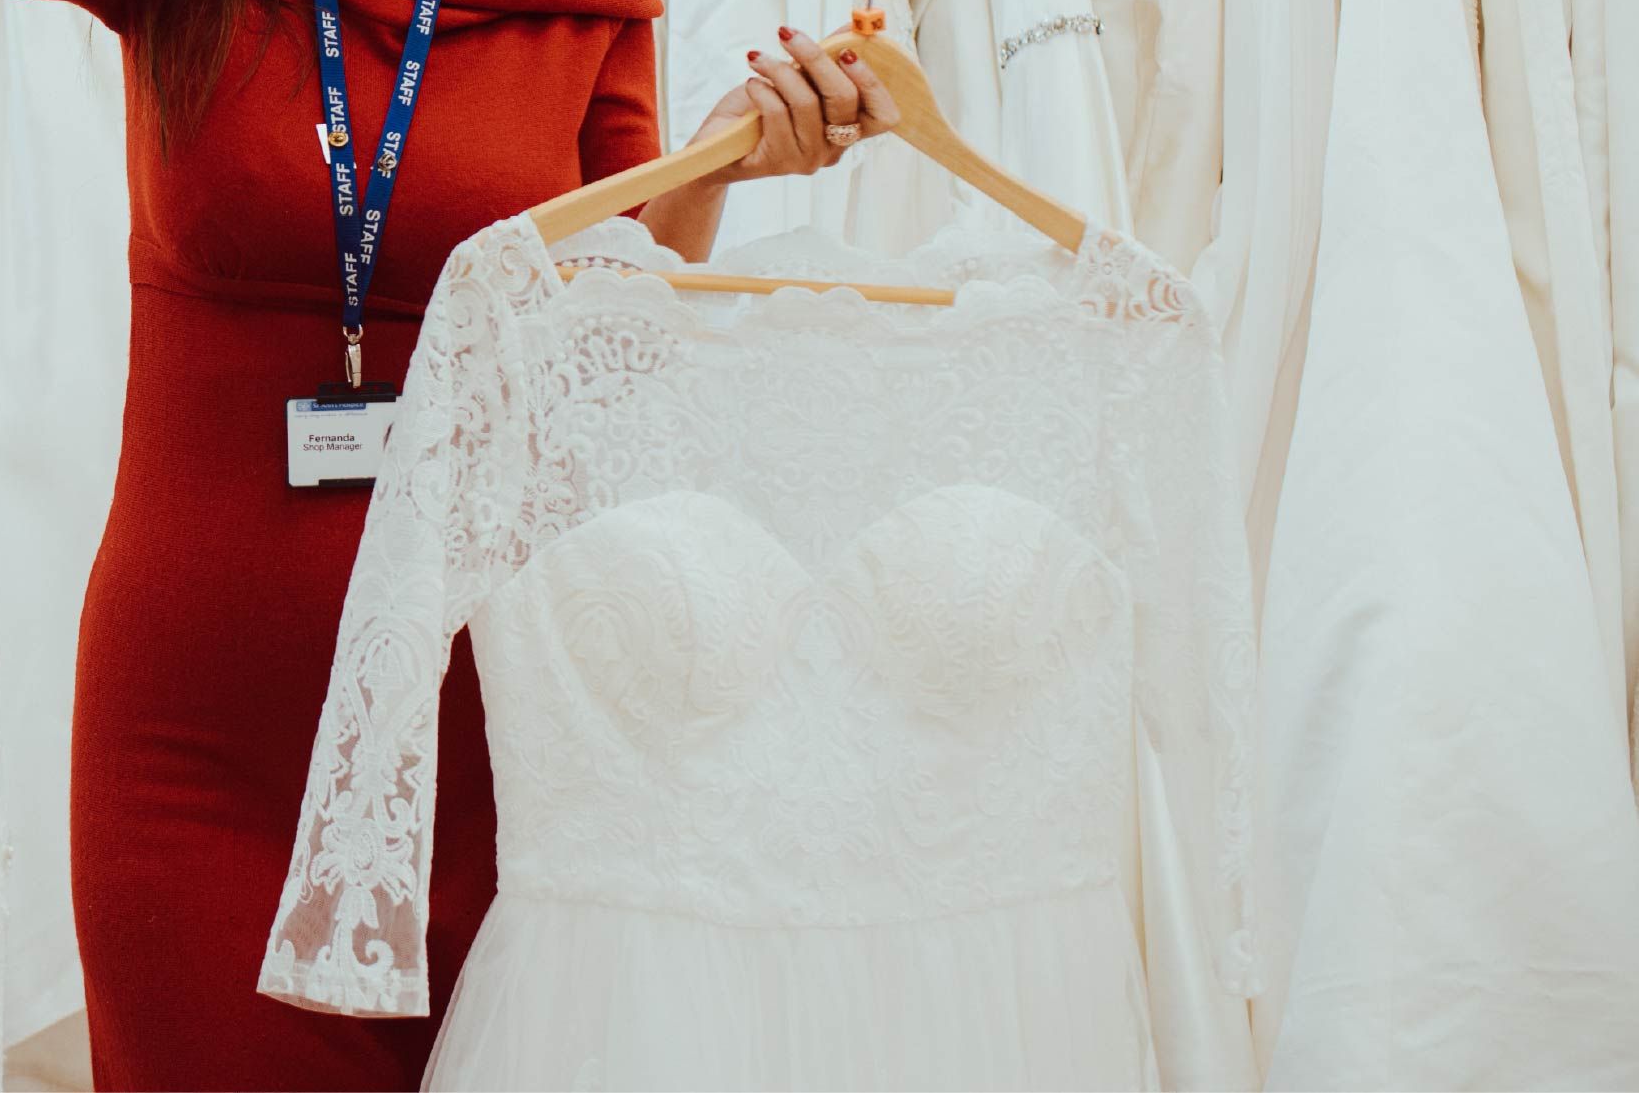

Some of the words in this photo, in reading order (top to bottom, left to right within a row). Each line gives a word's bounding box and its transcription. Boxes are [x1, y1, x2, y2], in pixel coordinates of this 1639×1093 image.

[322, 11, 340, 58] STAFF
[397, 60, 421, 107] STAFF
[328, 86, 347, 133] STAFF
[377, 131, 402, 179] STAF
[336, 162, 353, 216] STAFF
[360, 209, 381, 265] STAFF
[344, 253, 358, 306] STAFF
[308, 433, 355, 442] Fernanda
[326, 443, 362, 451] Manager
